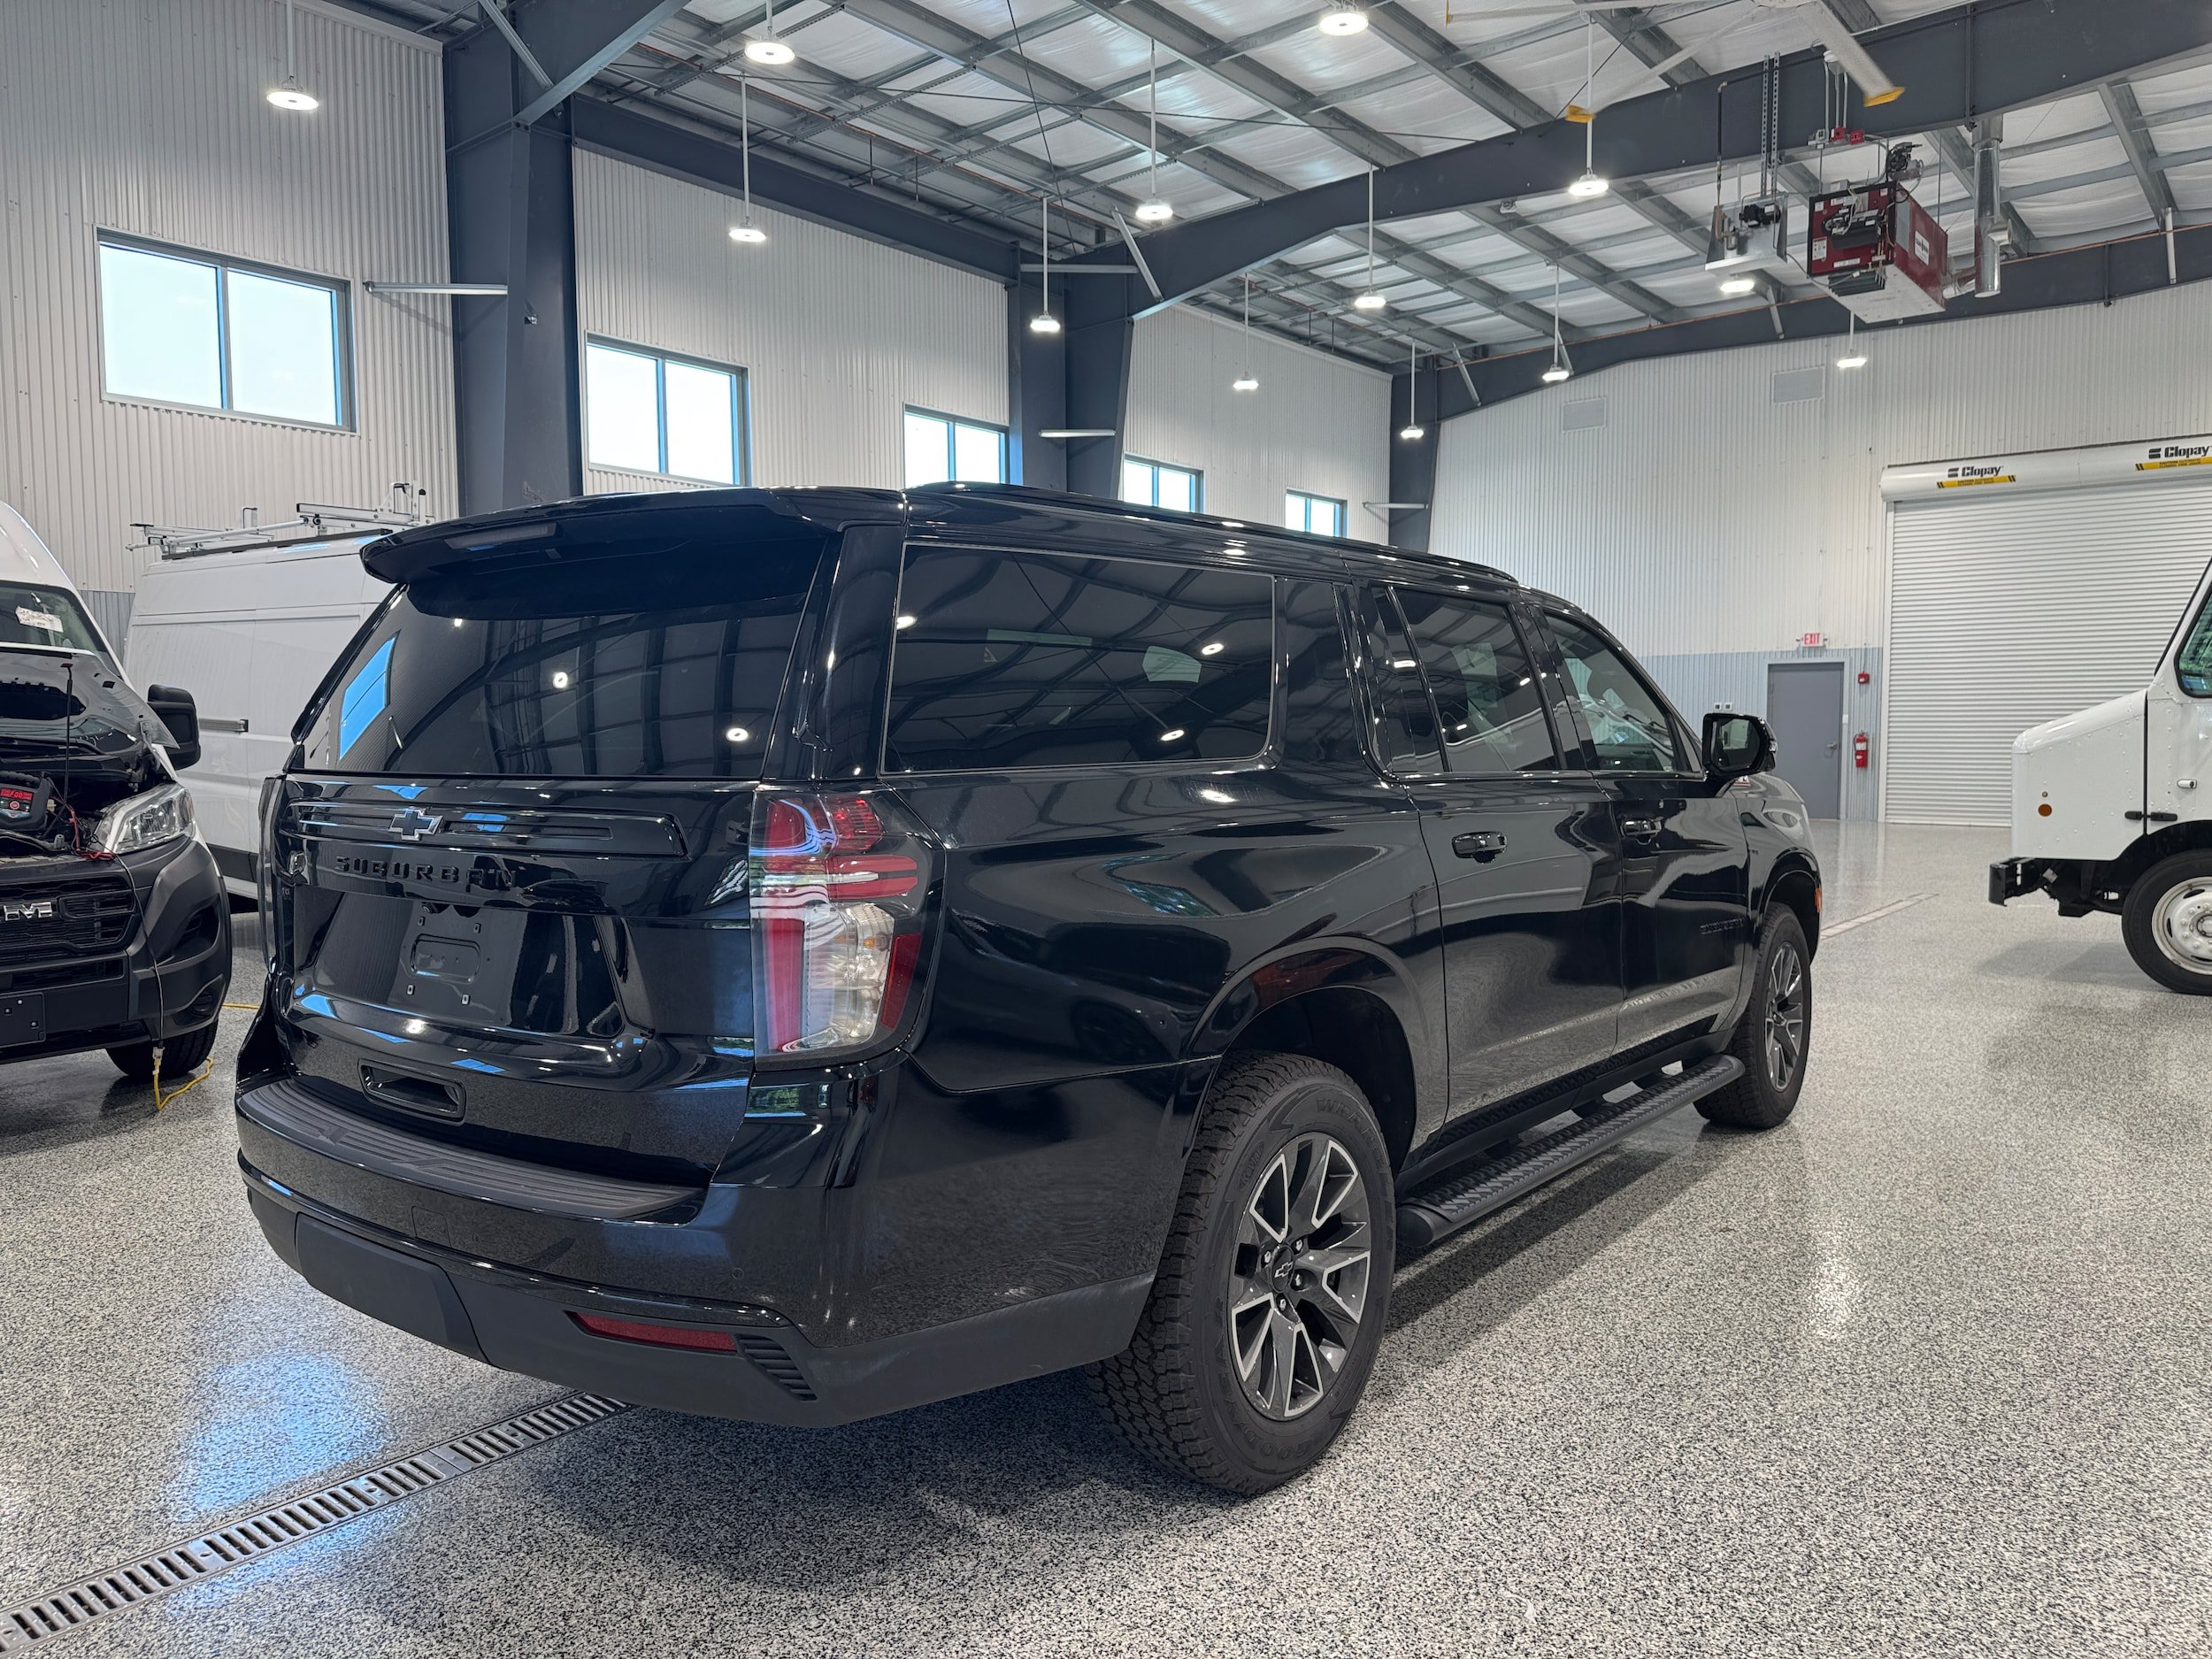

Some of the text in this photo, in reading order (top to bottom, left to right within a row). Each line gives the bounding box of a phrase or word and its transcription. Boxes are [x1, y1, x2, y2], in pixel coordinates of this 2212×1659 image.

[2165, 446, 2209, 458] Clopay
[1962, 465, 2001, 477] Clopay
[1804, 633, 1821, 644] EXIT
[335, 855, 516, 887] SUBURBAN
